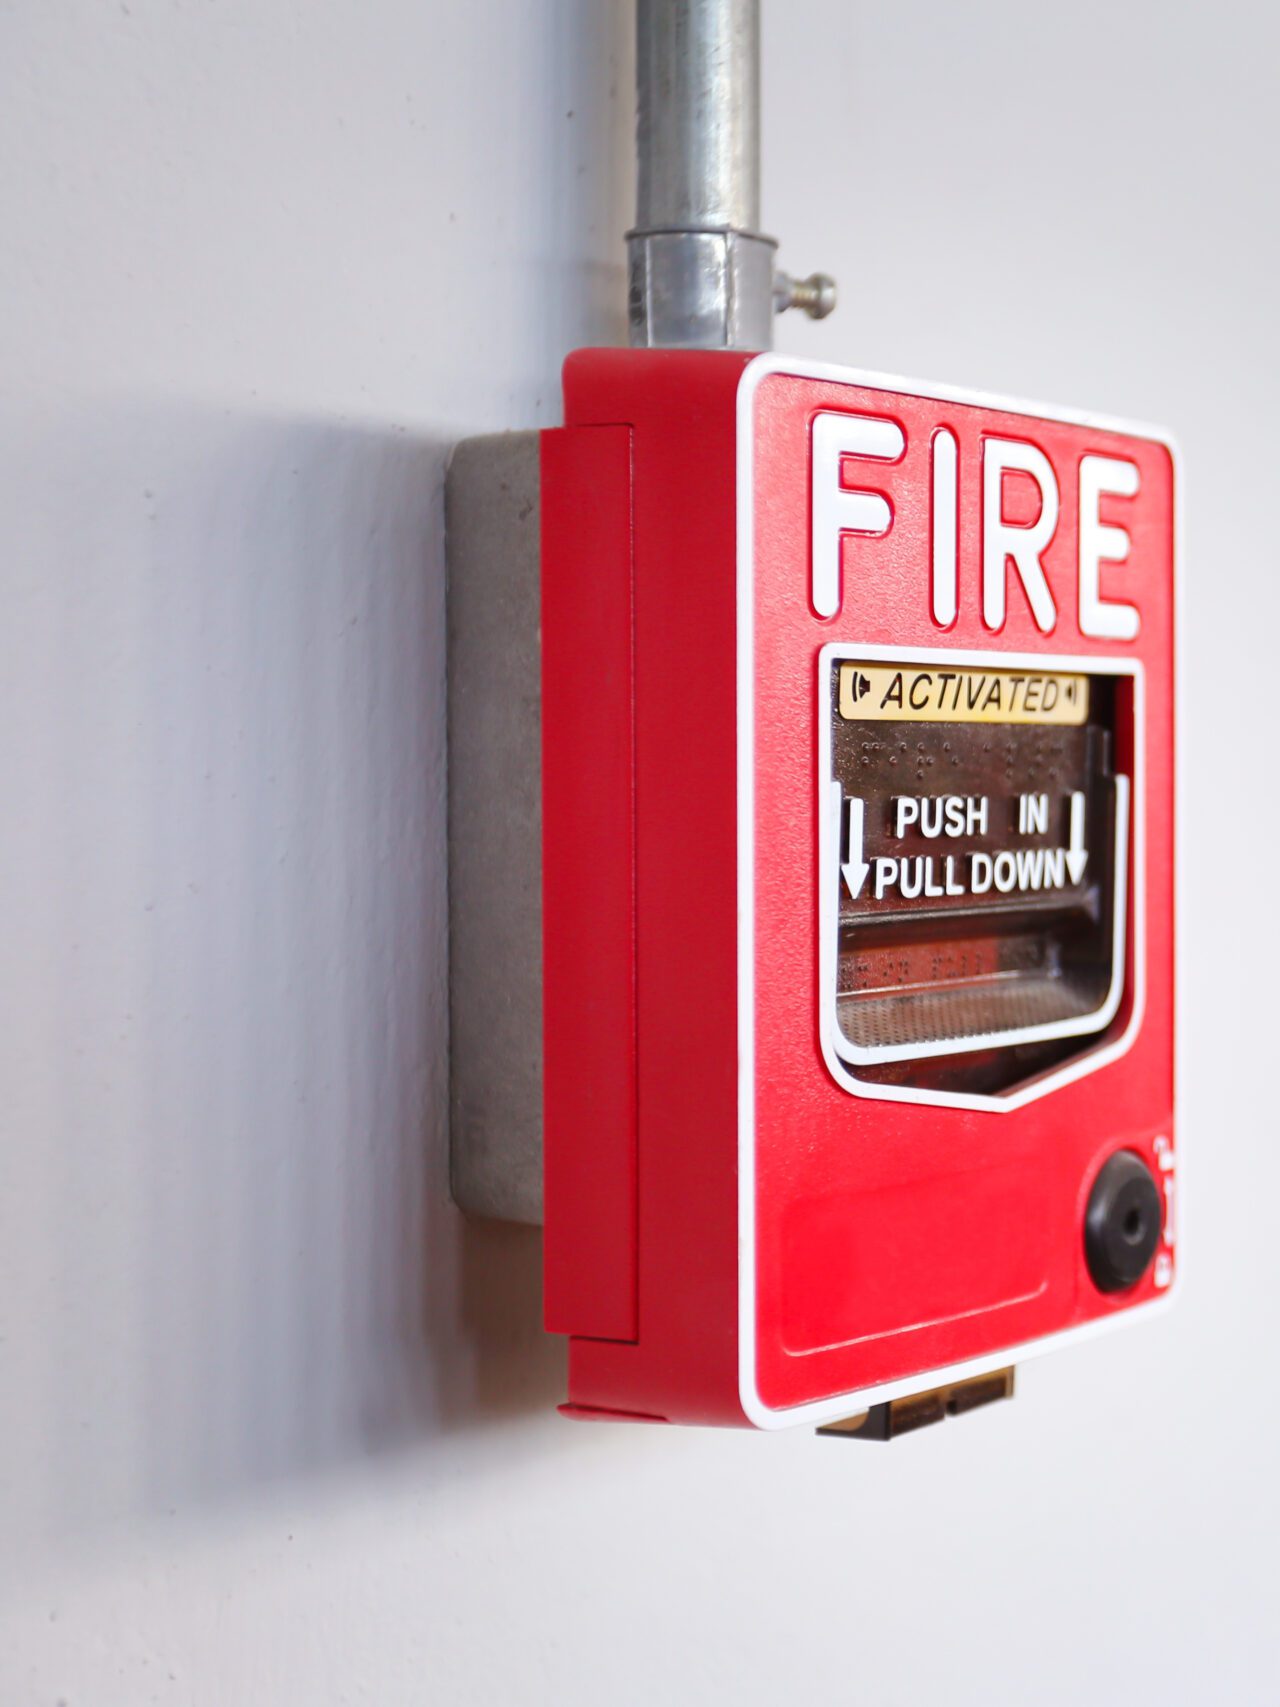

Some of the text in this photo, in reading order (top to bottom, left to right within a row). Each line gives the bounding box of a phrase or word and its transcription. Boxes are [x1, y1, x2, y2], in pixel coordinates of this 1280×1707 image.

[810, 412, 1141, 639] FIRE
[880, 672, 1059, 712] ACTIVATED
[896, 793, 1048, 839] PUSH IN
[875, 848, 1065, 900] PULL DOWN
